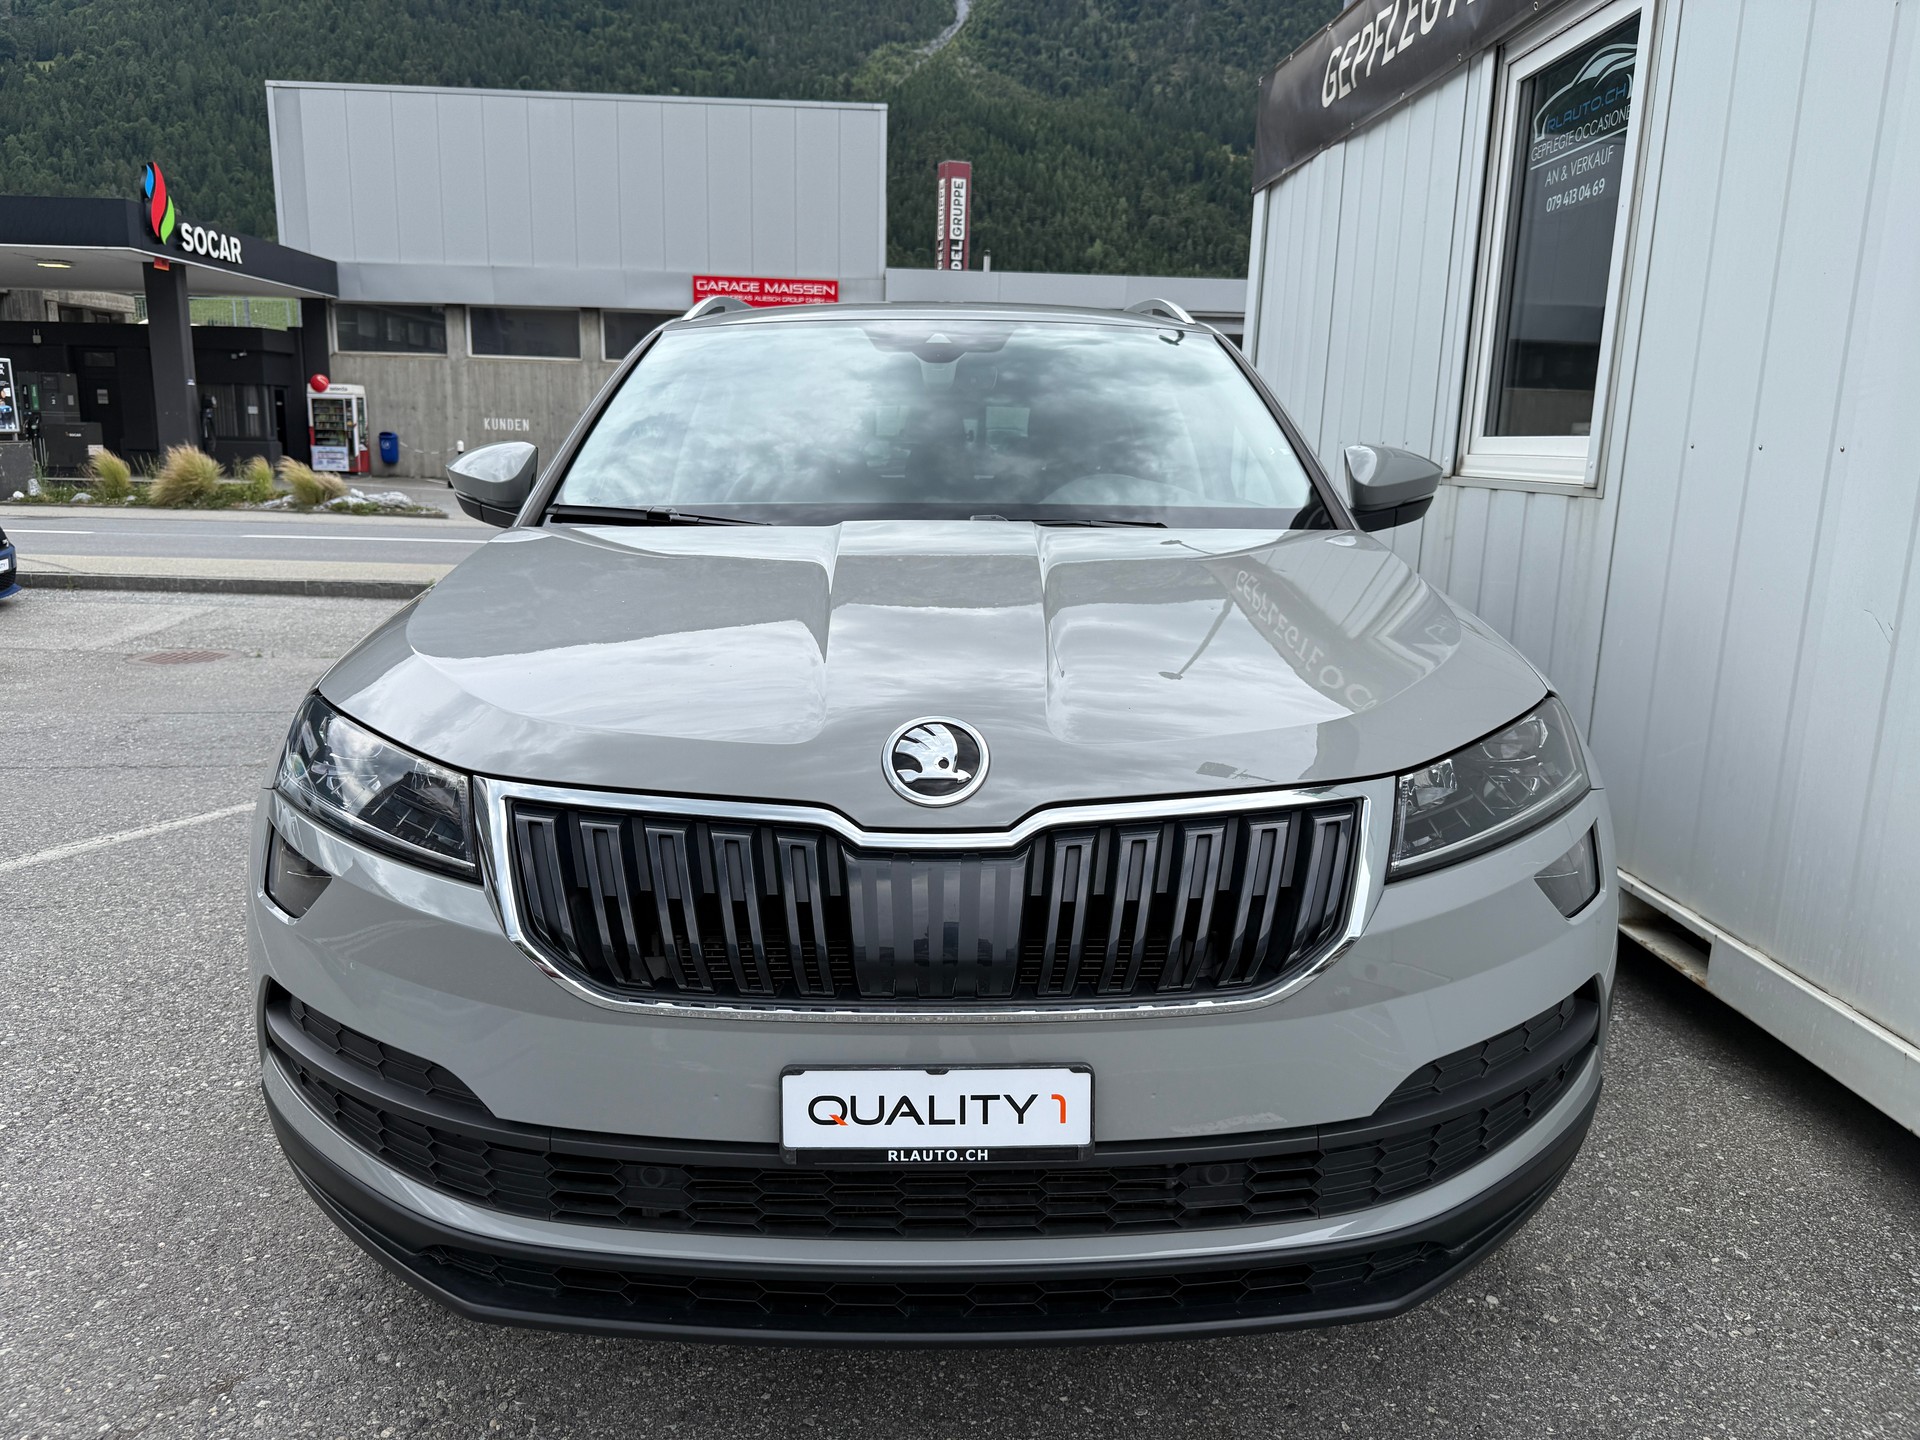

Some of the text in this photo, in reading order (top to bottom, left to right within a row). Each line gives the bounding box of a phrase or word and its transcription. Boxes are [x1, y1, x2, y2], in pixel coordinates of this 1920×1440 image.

[1322, 0, 1475, 108] GEPFLEG
[1546, 83, 1627, 130] RLAUTO.CH
[1531, 130, 1574, 162] GEPFLEGTE
[1544, 145, 1614, 187] AN & VERKAUF
[1546, 178, 1605, 212] 079 413 04 69
[951, 181, 964, 270] DEL GRUPPE
[181, 222, 243, 264] SOCAR
[696, 280, 836, 296] GARAGE MAISSEN
[484, 418, 530, 431] KUNDEN
[808, 1093, 1067, 1126] QUALITY 1
[887, 1149, 989, 1162] RLAUTO.CH
